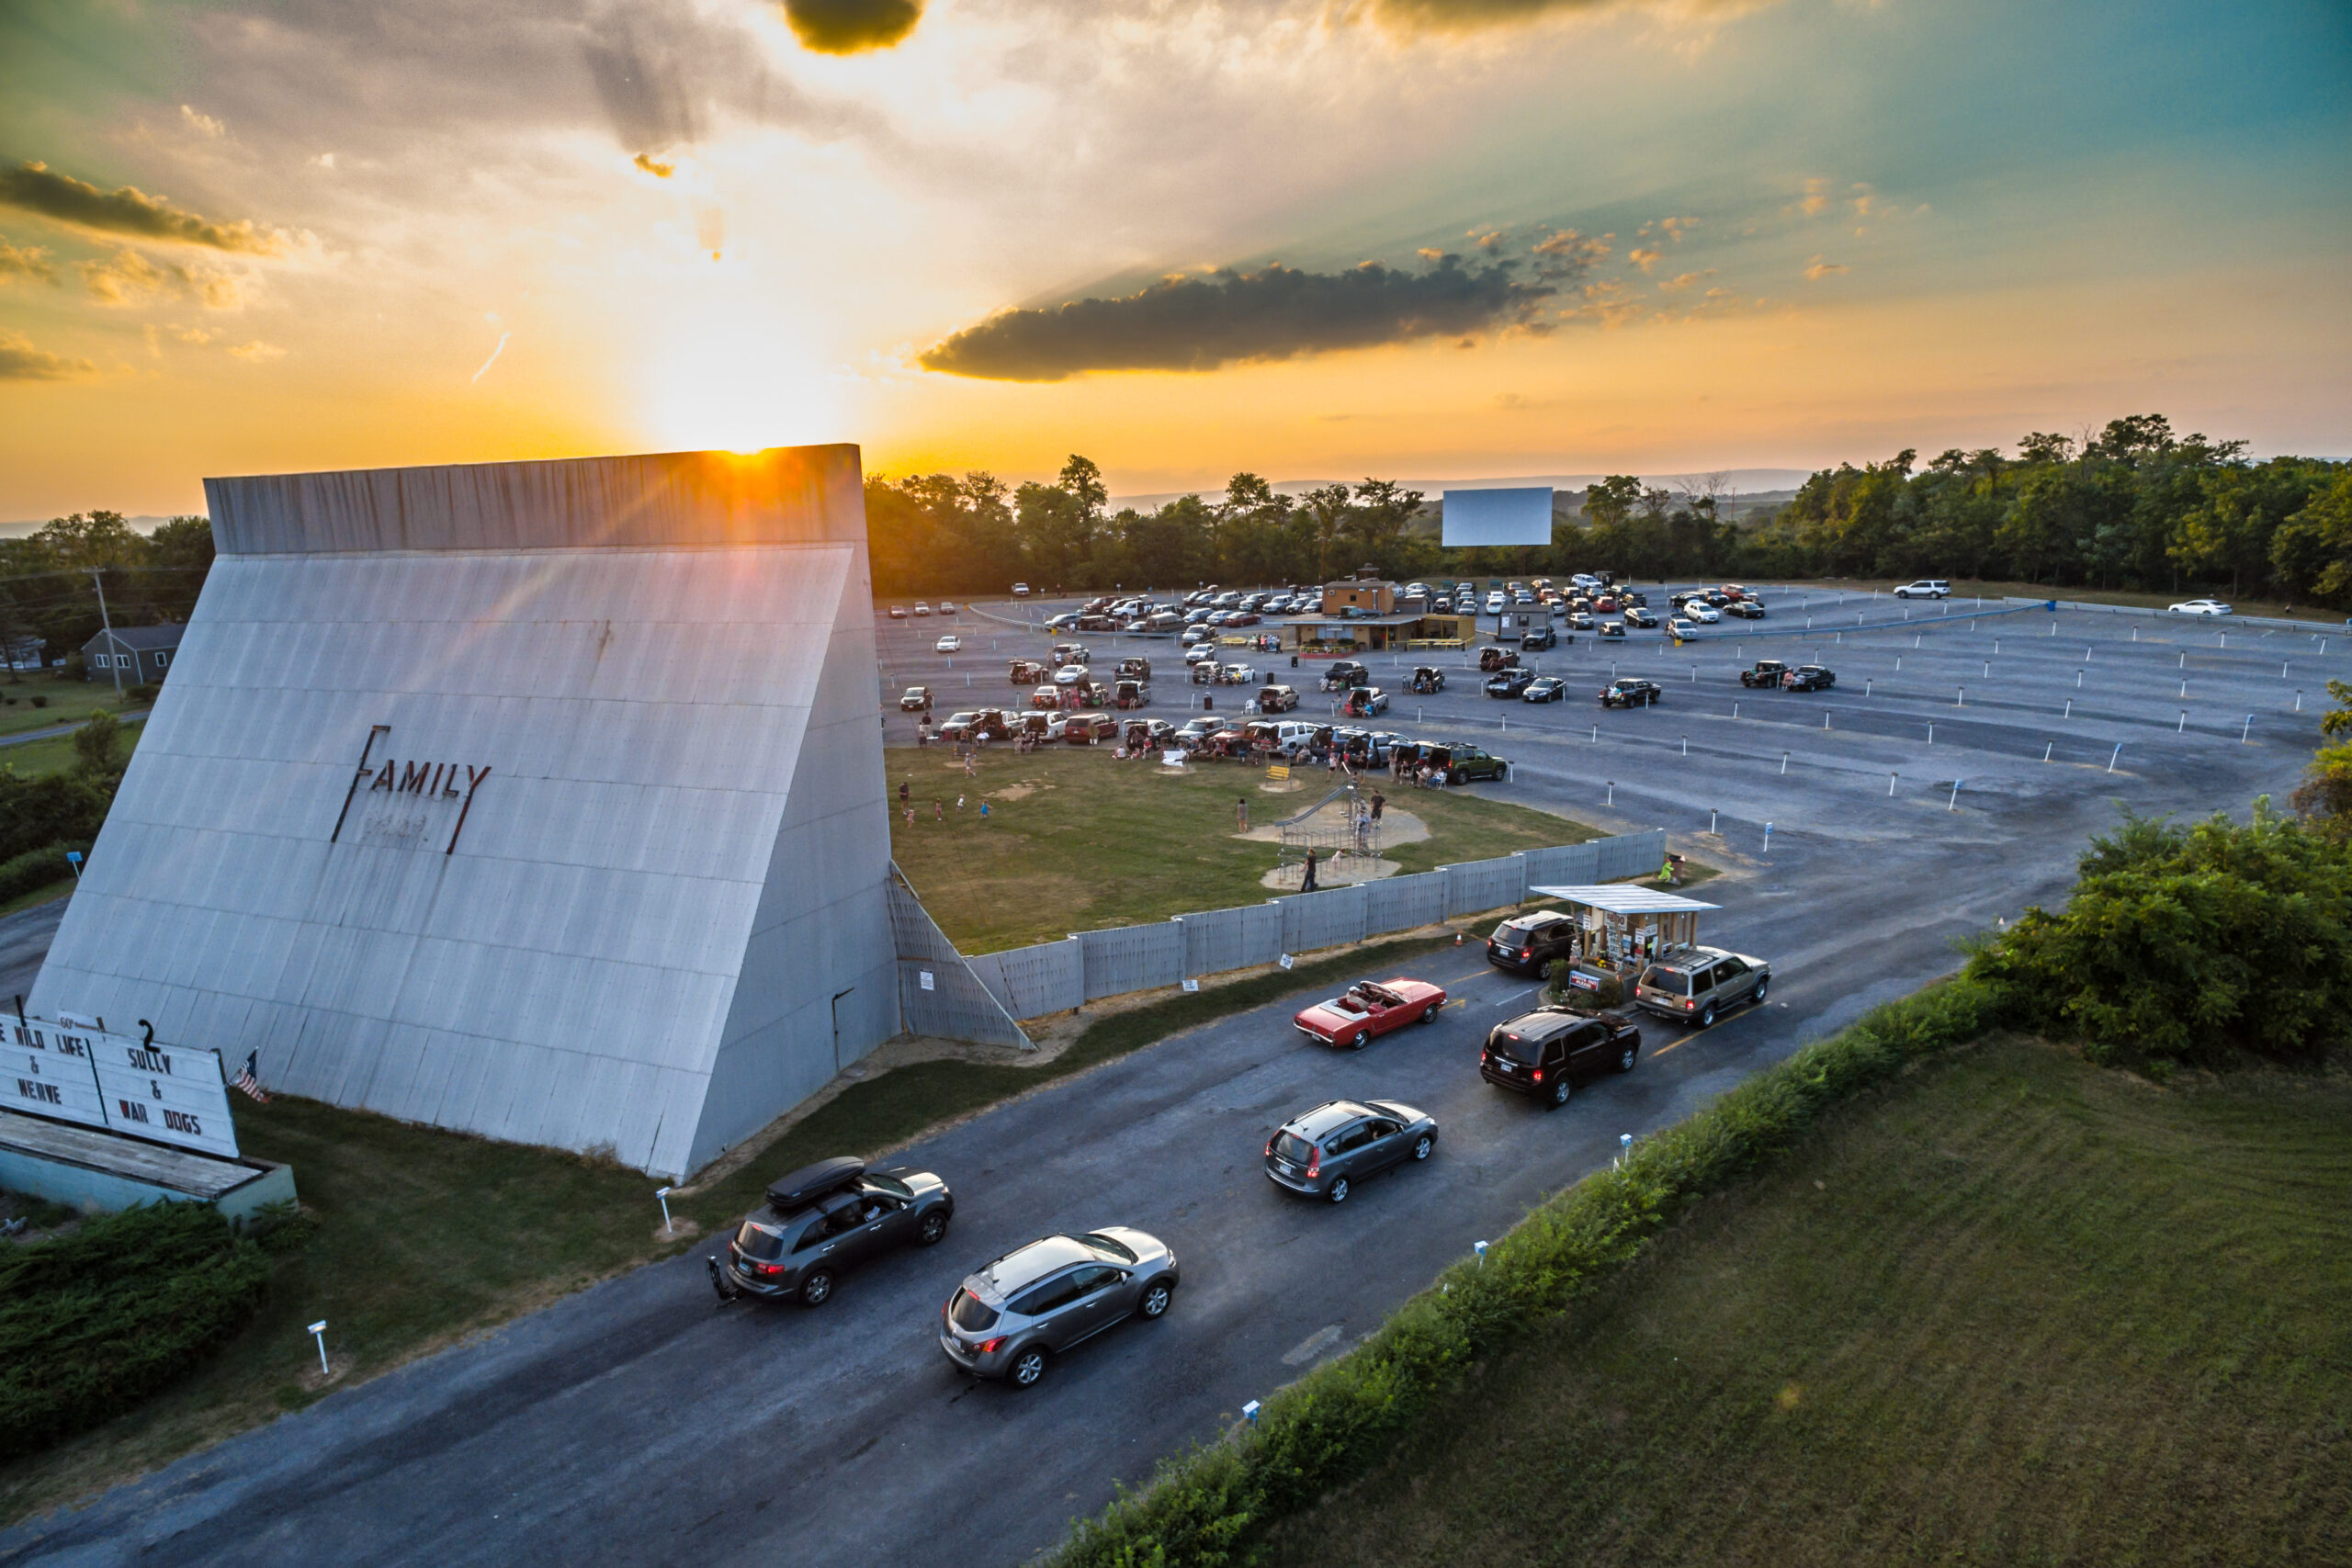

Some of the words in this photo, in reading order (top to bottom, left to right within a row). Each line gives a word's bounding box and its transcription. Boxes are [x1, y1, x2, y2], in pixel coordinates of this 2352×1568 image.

[331, 725, 492, 855] FAMILY
[14, 1026, 45, 1050] WILD
[55, 1033, 85, 1057] LIFE
[138, 1019, 161, 1054] 2
[29, 1055, 40, 1075] &
[128, 1048, 172, 1076] SULLY
[17, 1078, 62, 1106] NERVE
[150, 1079, 162, 1100] &
[119, 1099, 149, 1124] WAR
[163, 1109, 202, 1136] DOGS
